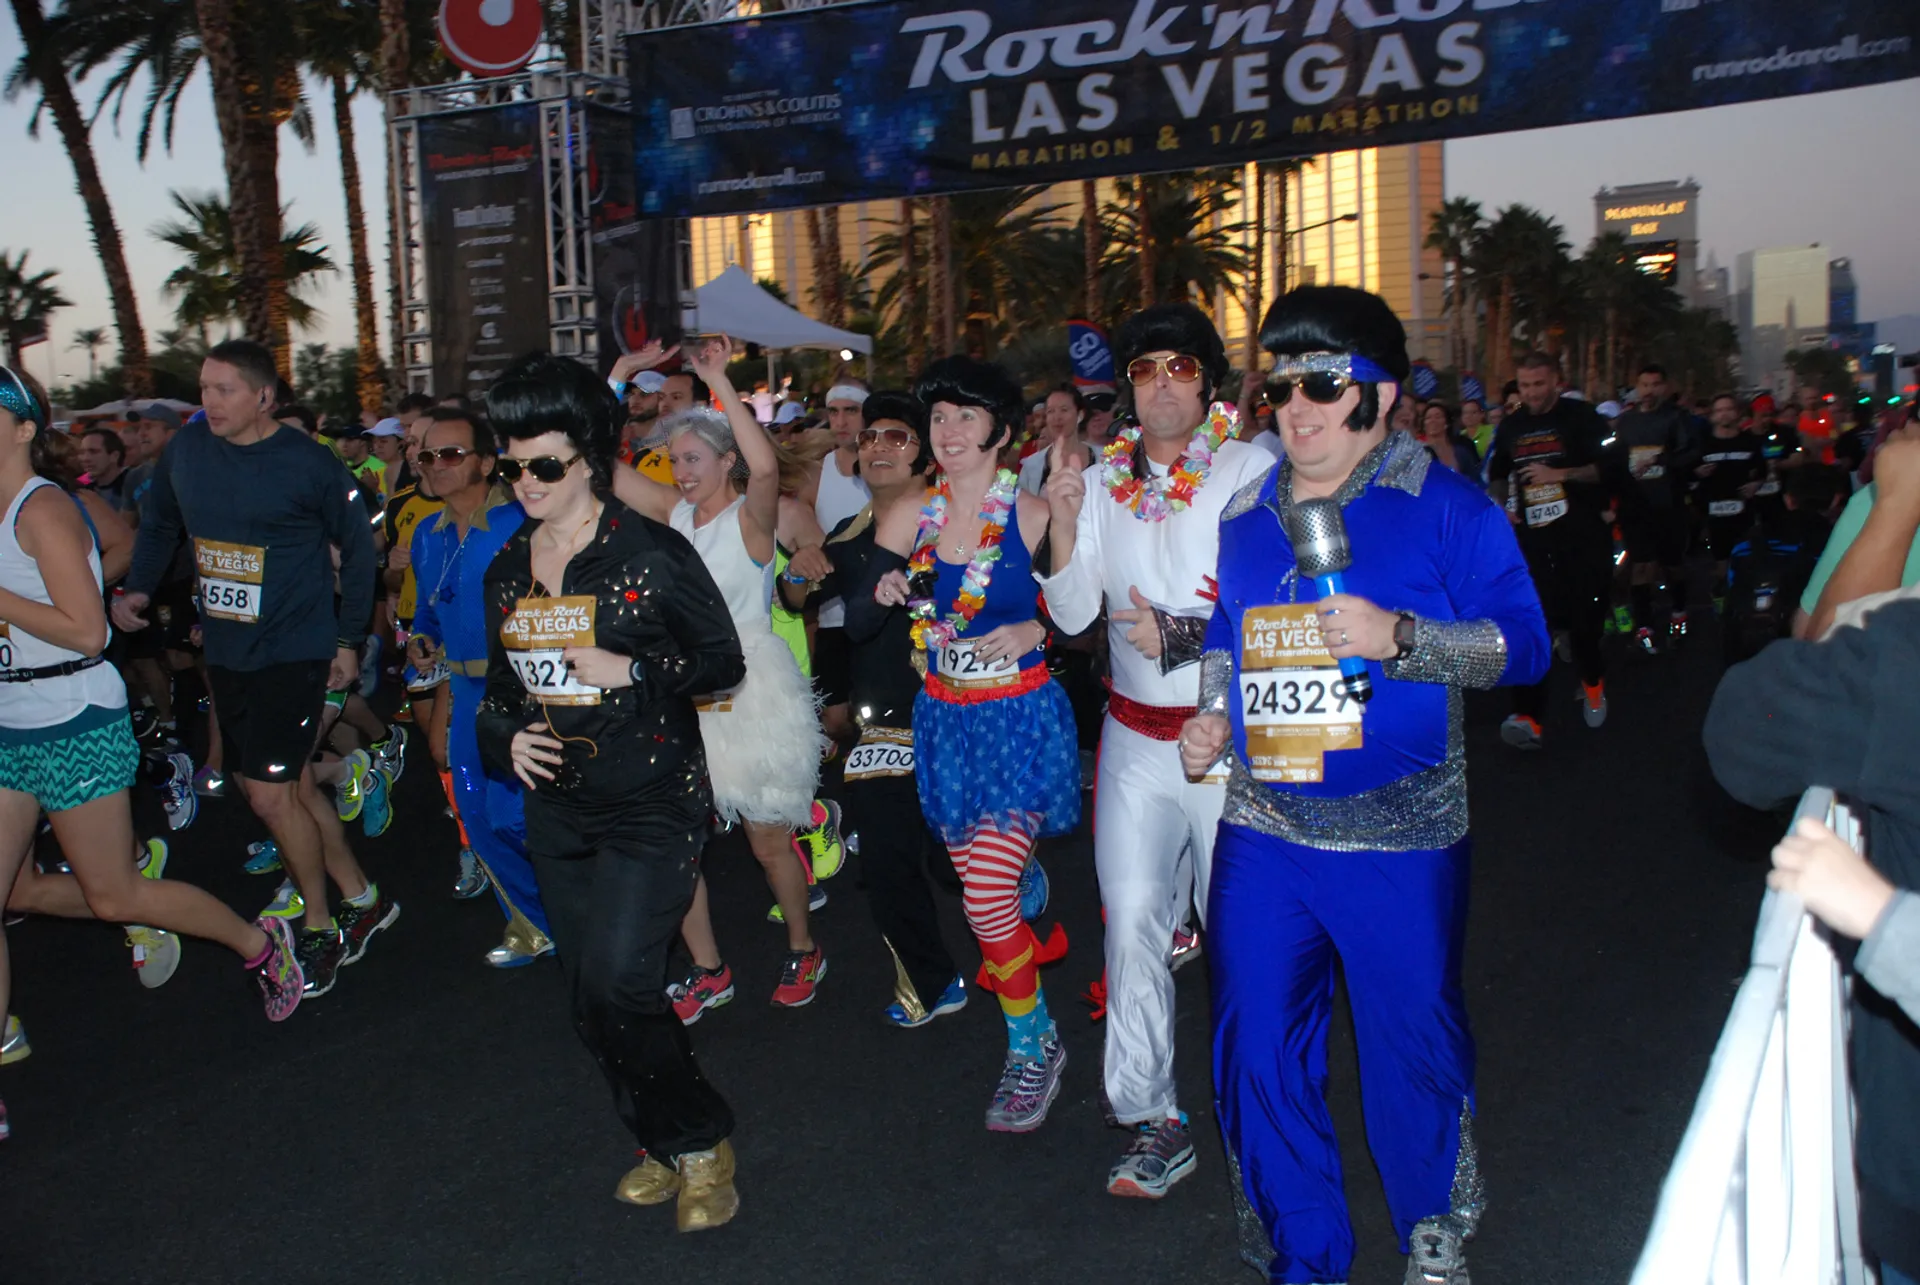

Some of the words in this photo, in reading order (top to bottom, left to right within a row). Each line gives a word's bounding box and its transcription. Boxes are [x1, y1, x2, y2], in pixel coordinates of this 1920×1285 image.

[899, 0, 1197, 88] Rock
[970, 73, 1118, 144] LAS
[1161, 21, 1486, 120] VEGAS
[971, 137, 1133, 170] MARATHON
[1156, 124, 1180, 151] &
[1209, 119, 1266, 145] 1/2
[1291, 94, 1479, 135] MARATHON
[216, 556, 260, 573] VEGAS
[516, 608, 541, 618] ock
[553, 605, 586, 617] Roll
[504, 619, 530, 634] LAS
[533, 616, 590, 633] VEGAS
[1252, 618, 1290, 632] Rock
[1245, 631, 1277, 650] LAS
[1280, 628, 1324, 648] VEG
[1276, 647, 1330, 657] marathon
[1245, 680, 1348, 716] 24329
[850, 747, 914, 769] 33700
